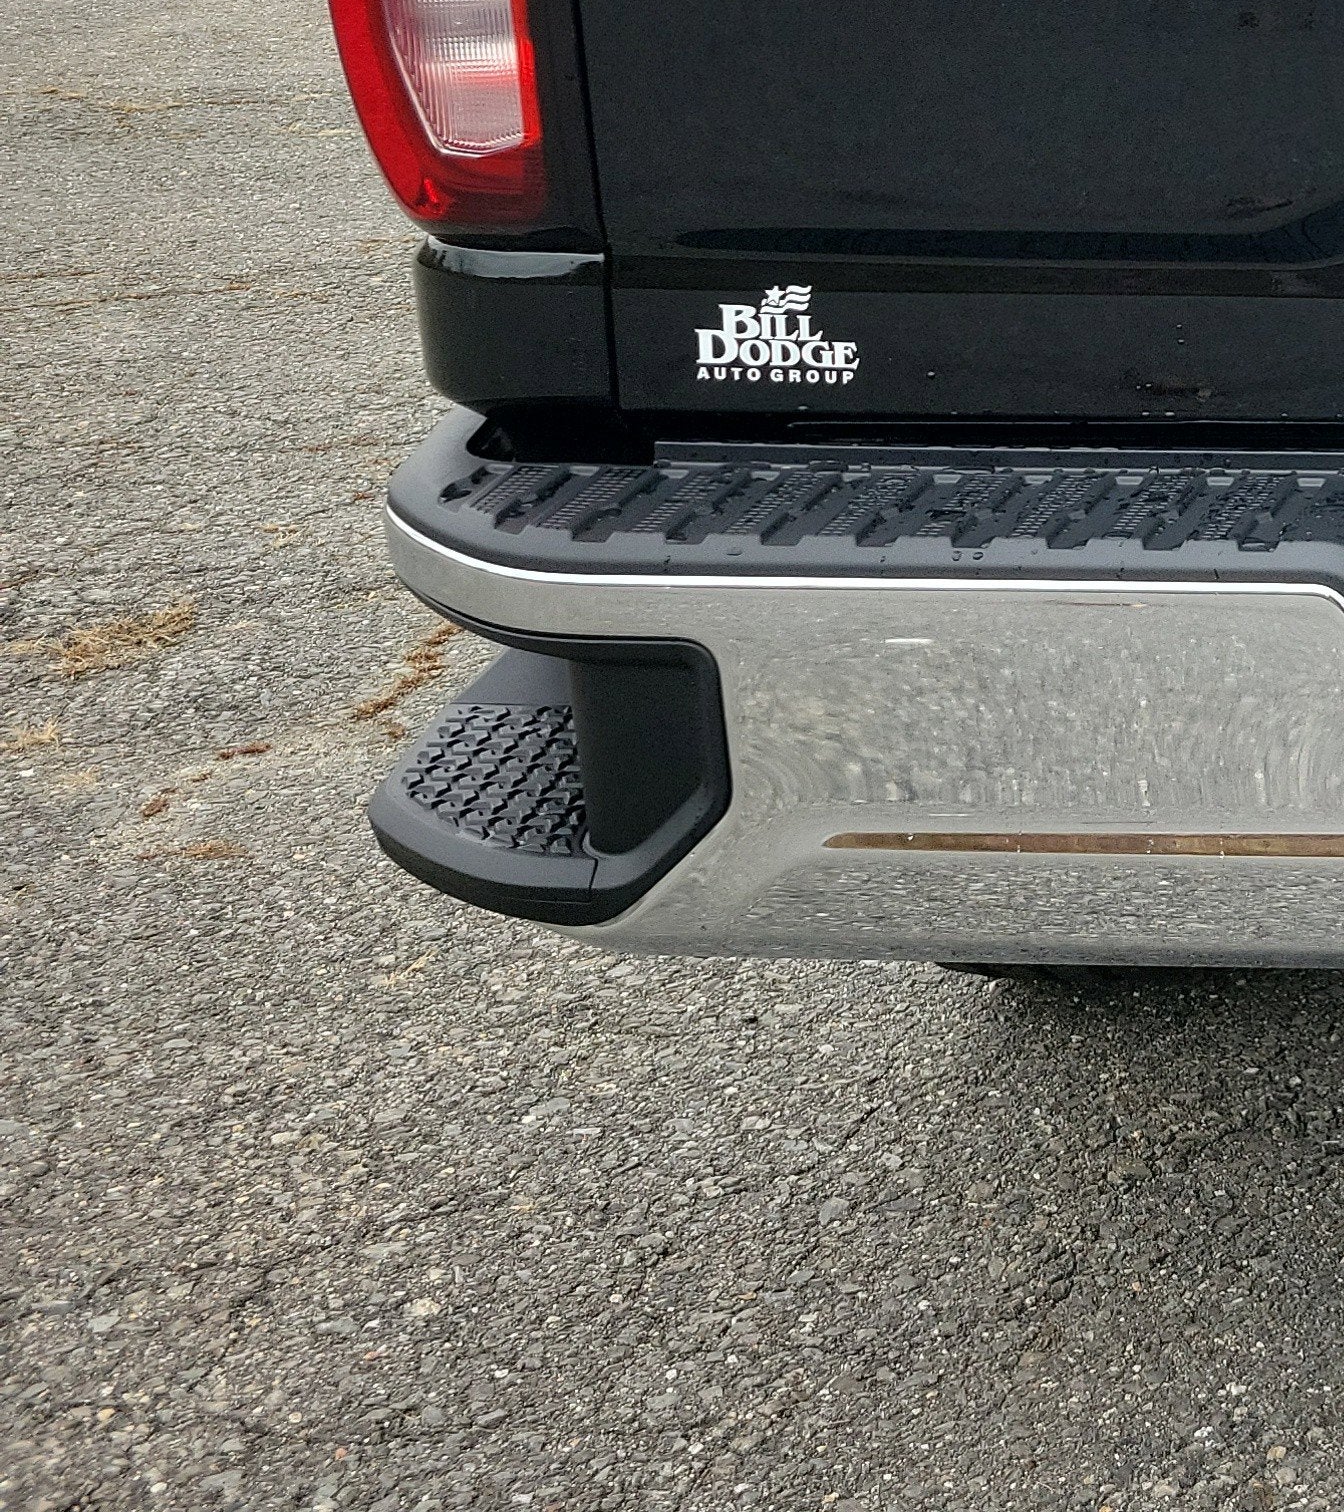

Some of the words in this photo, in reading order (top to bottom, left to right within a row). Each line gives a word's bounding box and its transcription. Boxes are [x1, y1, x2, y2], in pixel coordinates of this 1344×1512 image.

[718, 303, 824, 341] BILL
[694, 328, 860, 370] DODGE
[696, 366, 762, 382] AUTO
[769, 368, 855, 385] GROUP
